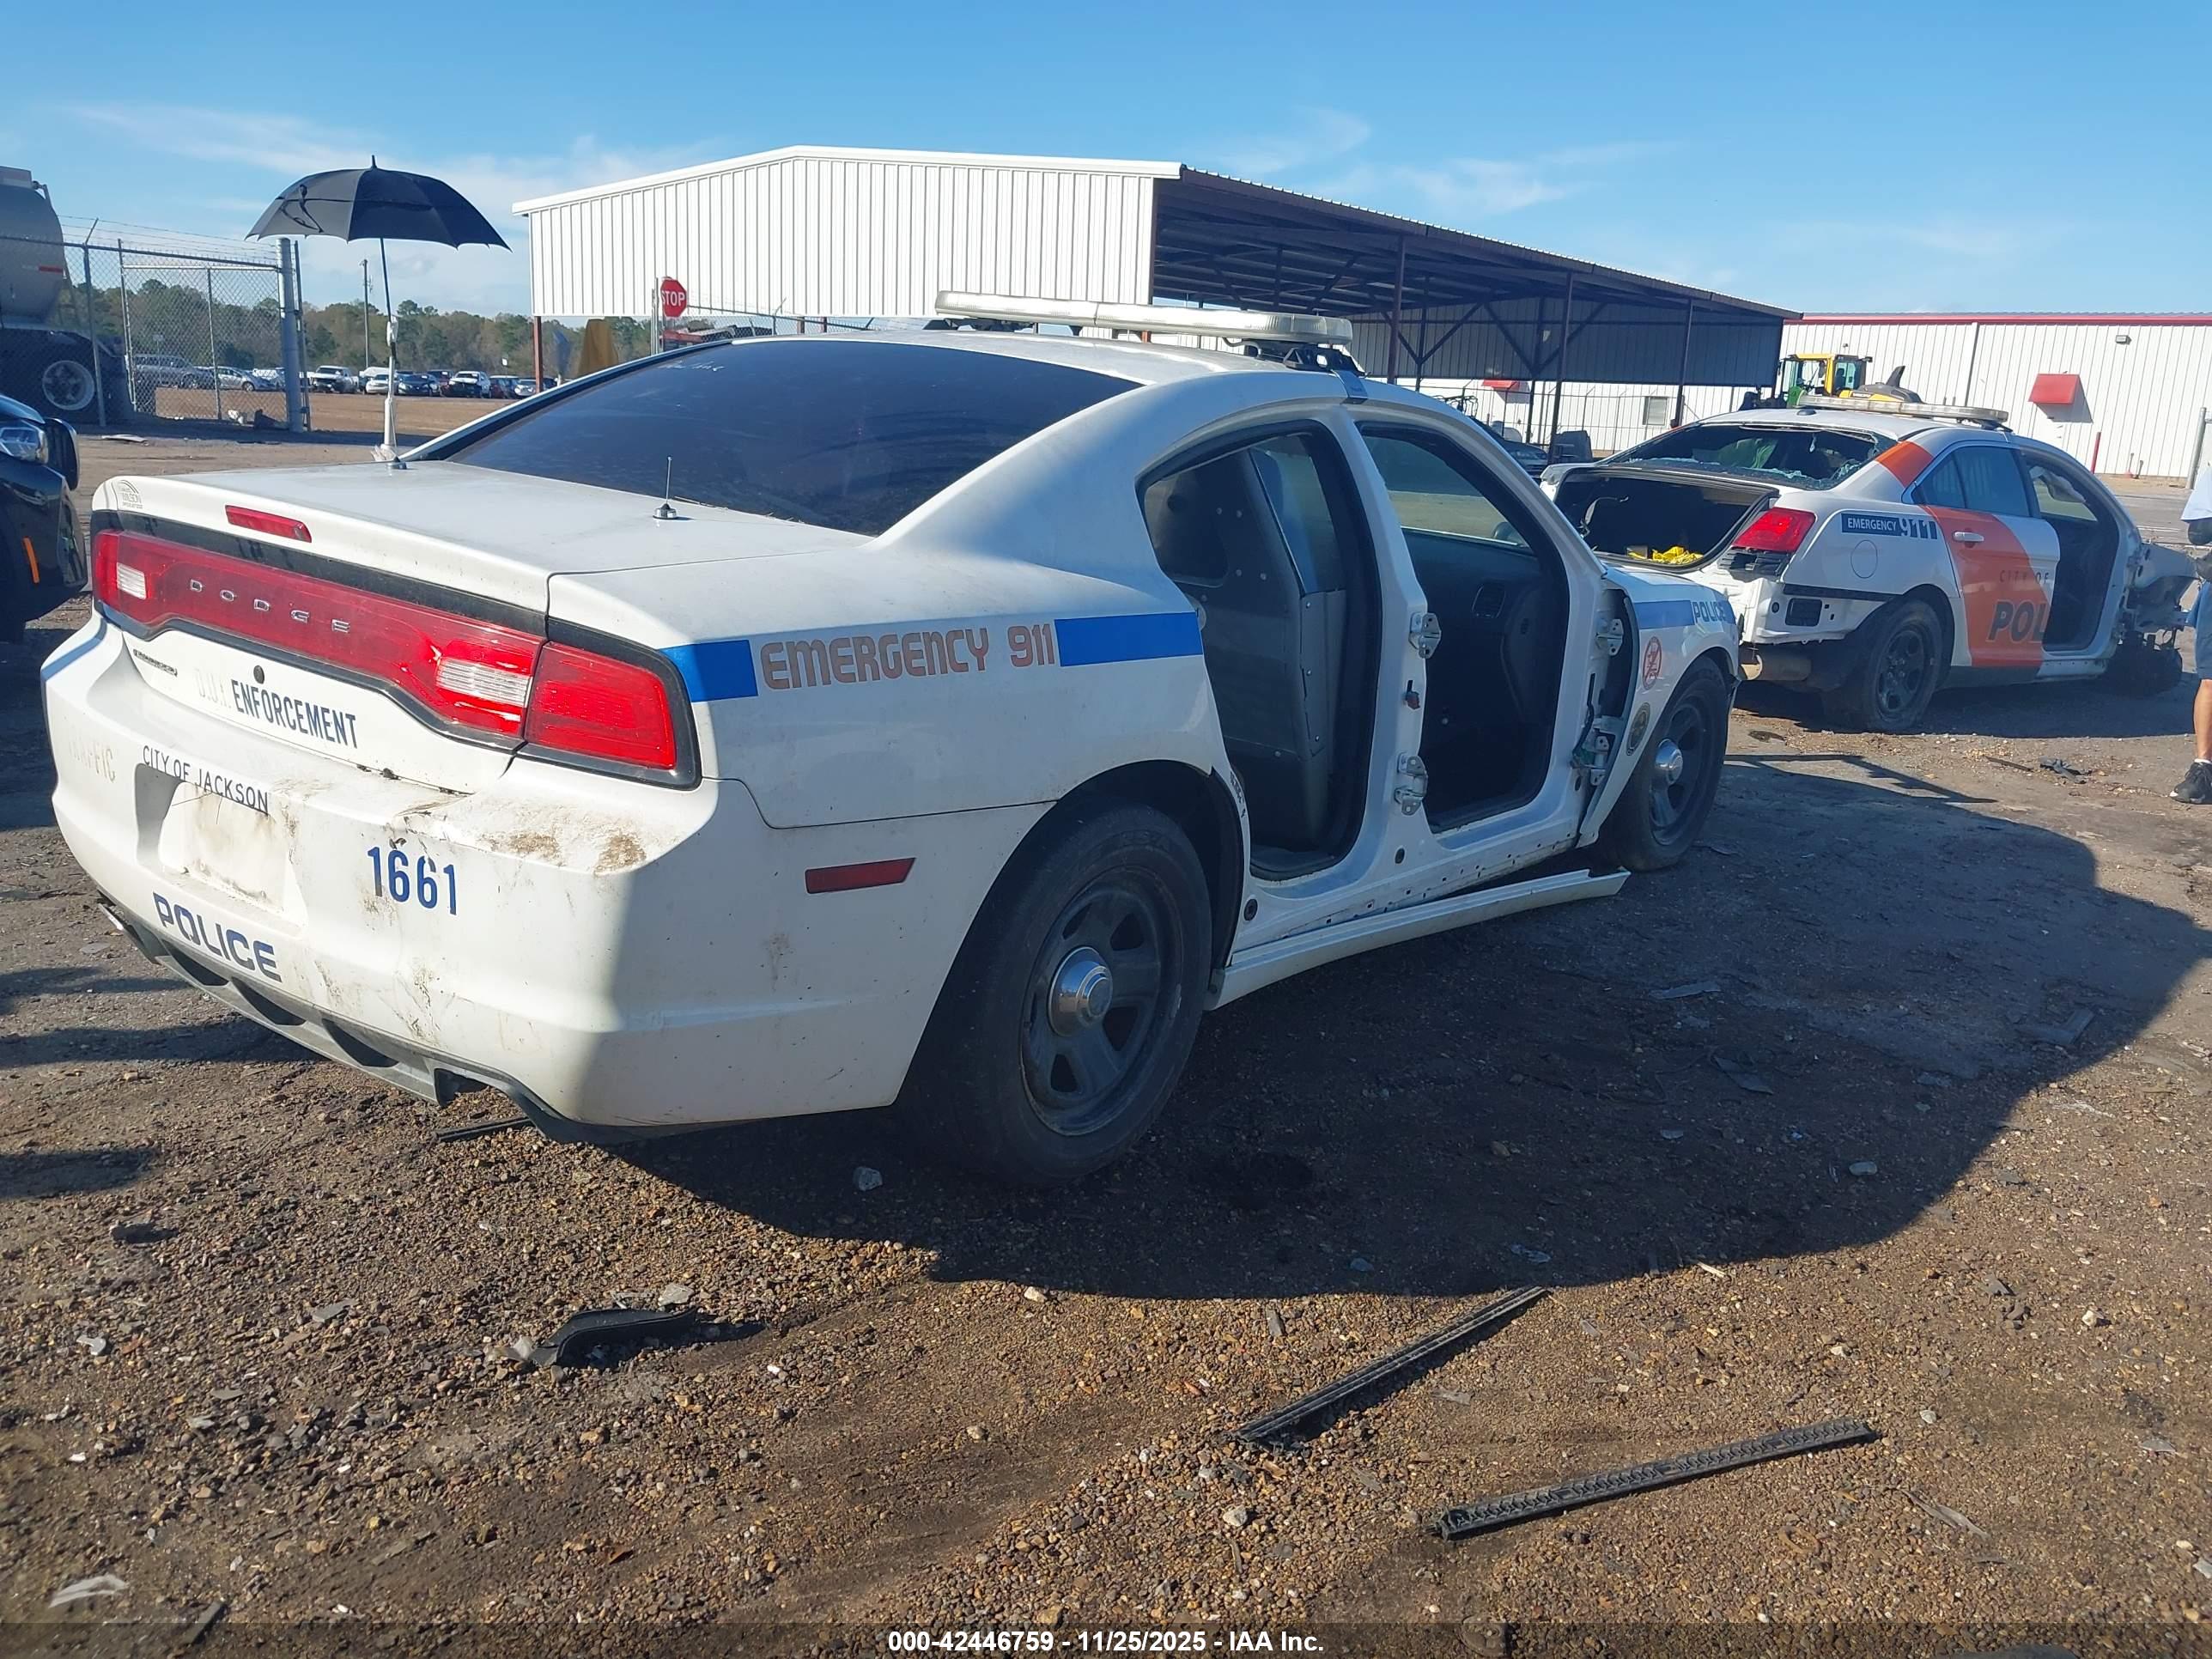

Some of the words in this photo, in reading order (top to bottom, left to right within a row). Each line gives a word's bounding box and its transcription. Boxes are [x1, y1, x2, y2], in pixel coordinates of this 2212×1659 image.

[661, 290, 685, 307] STOP
[1847, 518, 1897, 532] EMERGENCY
[1899, 518, 1933, 539] 911
[190, 579, 351, 634] DODGE
[1999, 570, 2029, 583] CITY
[2035, 571, 2050, 585] OF
[1985, 599, 2048, 644] POL
[760, 628, 989, 690] EMERGENCY
[1007, 623, 1055, 667] 911
[231, 678, 358, 749] ENFORCEMENT
[143, 745, 170, 774] CITY
[173, 759, 191, 781] OF
[194, 769, 269, 816] JACKSON
[368, 846, 457, 916] 1661
[153, 890, 283, 983] POLICE
